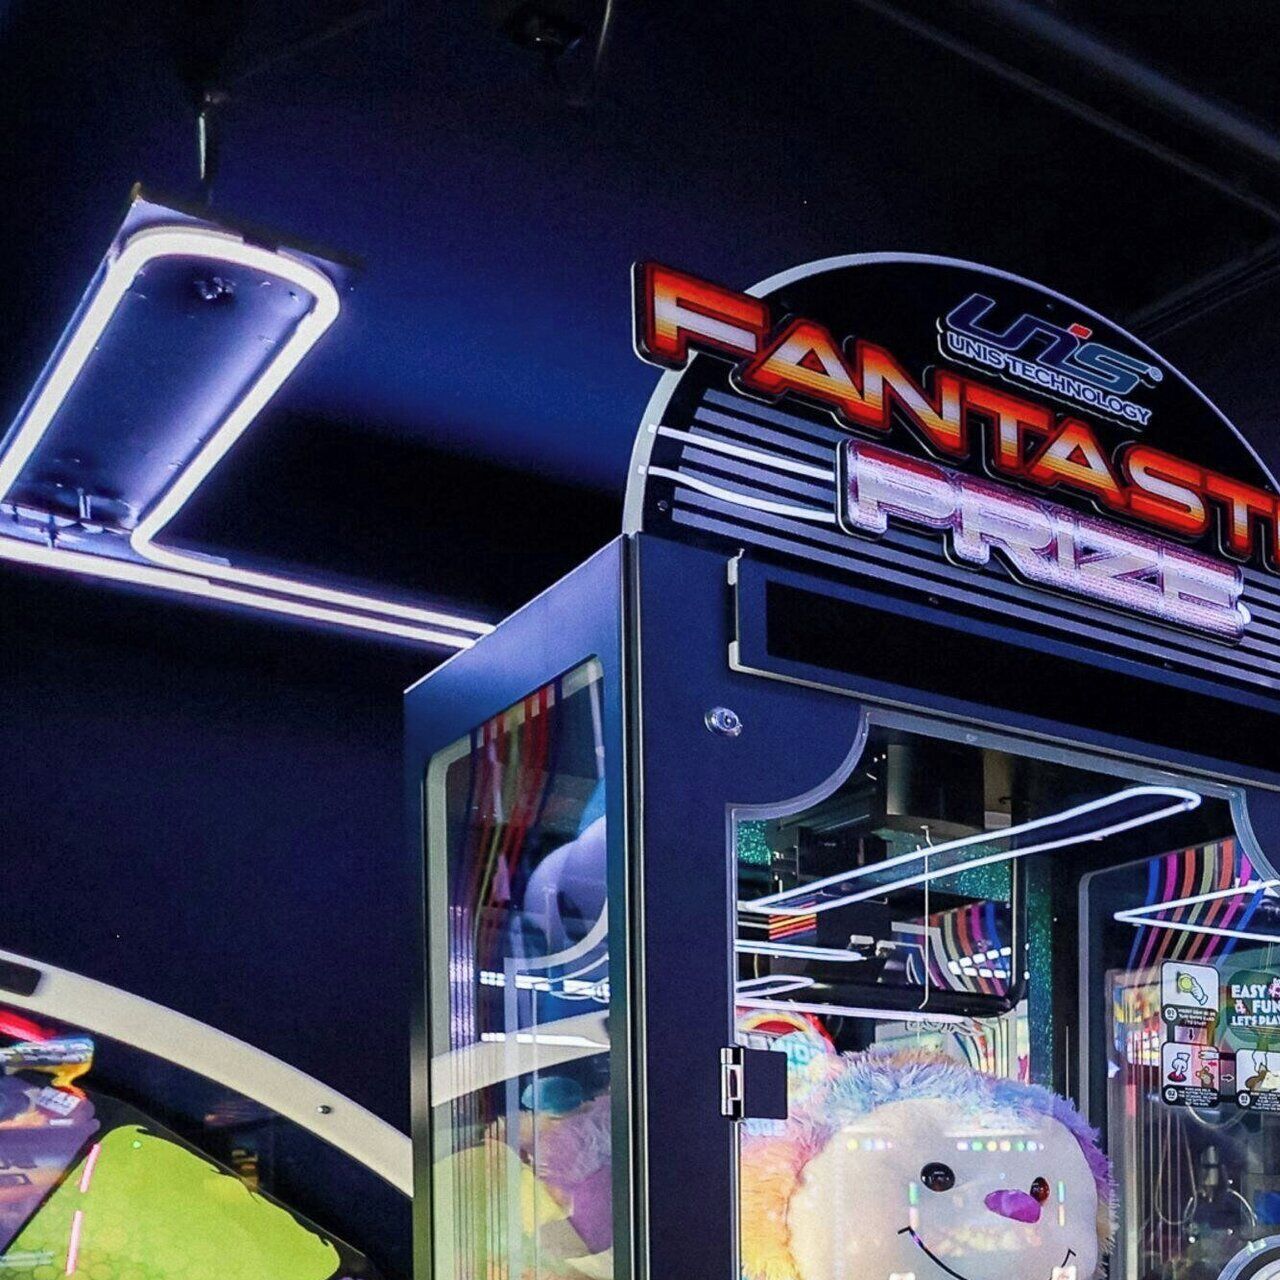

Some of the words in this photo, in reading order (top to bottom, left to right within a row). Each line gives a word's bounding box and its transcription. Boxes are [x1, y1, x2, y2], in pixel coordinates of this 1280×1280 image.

[946, 332, 1004, 369] UNIS
[1004, 353, 1152, 426] TECHNOLOGY
[837, 438, 1244, 646] PRIZE
[1231, 984, 1266, 999] EASY
